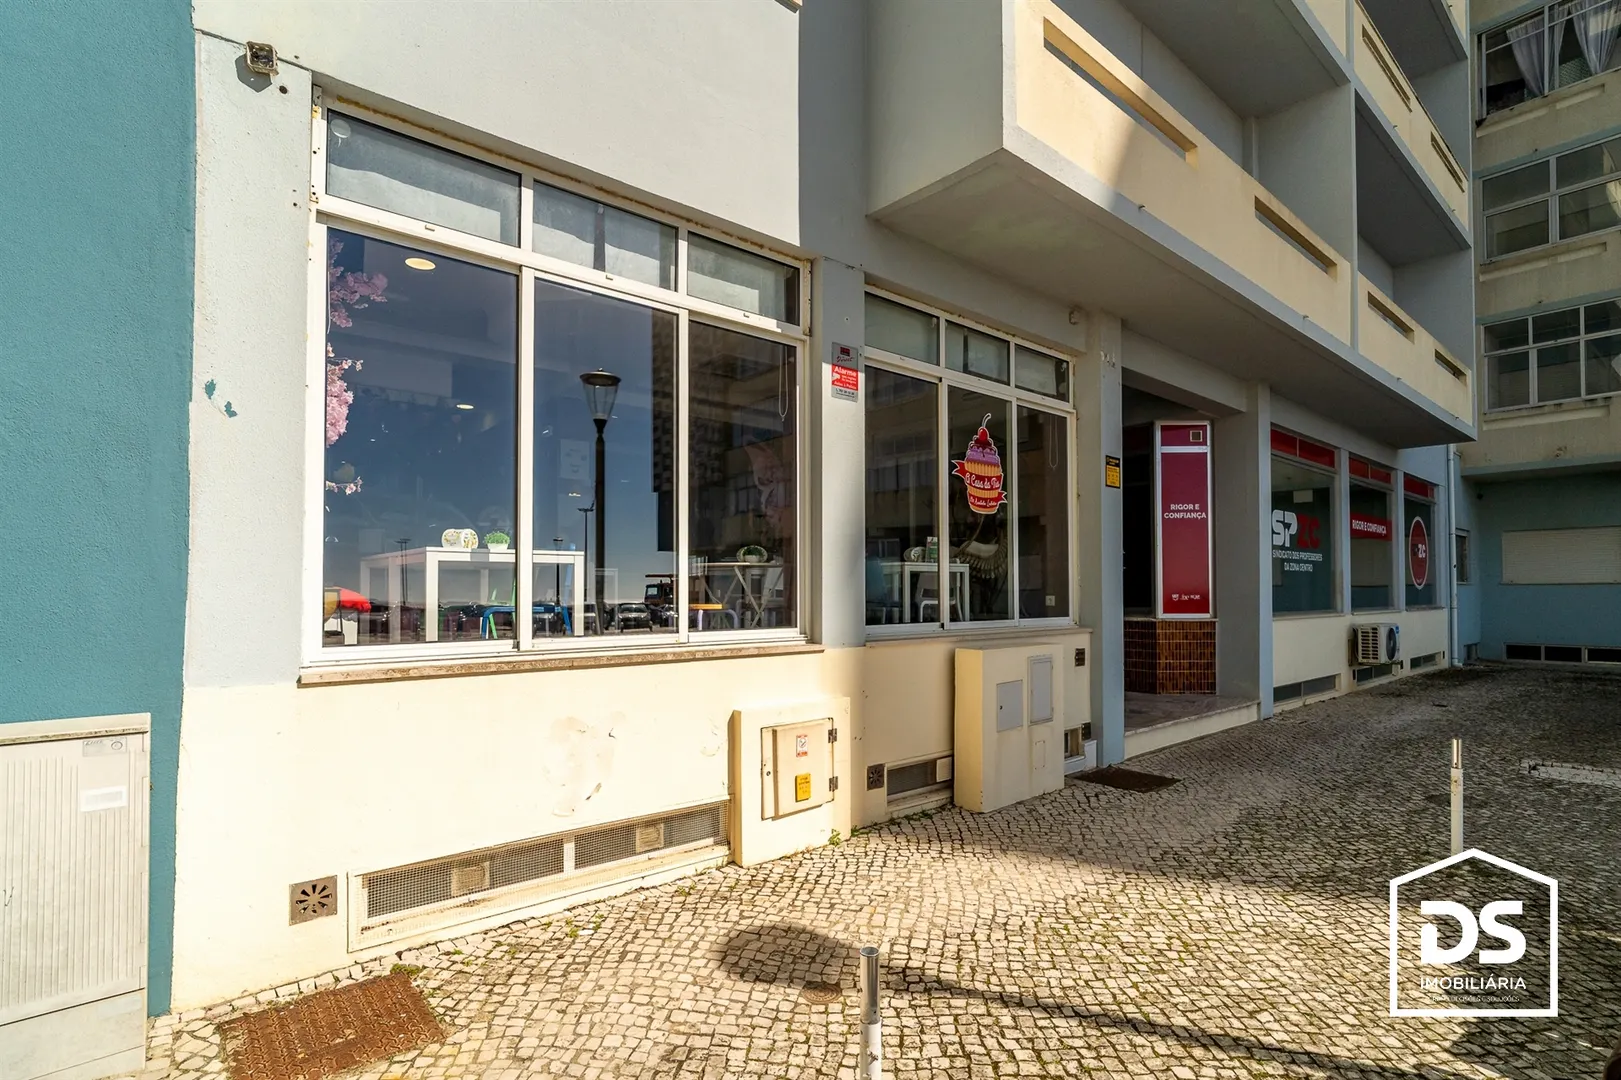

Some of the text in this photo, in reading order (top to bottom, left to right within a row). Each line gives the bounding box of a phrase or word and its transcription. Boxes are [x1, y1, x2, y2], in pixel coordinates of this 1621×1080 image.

[833, 366, 857, 377] Alarme
[1163, 512, 1207, 520] CONFIANÇA
[1352, 519, 1364, 531] RIGOR
[1367, 522, 1387, 536] CONFIANÇA
[1272, 549, 1323, 561] SINDICATO DOS PROFESSORES
[1284, 562, 1313, 572] DA ZONA CENTRO
